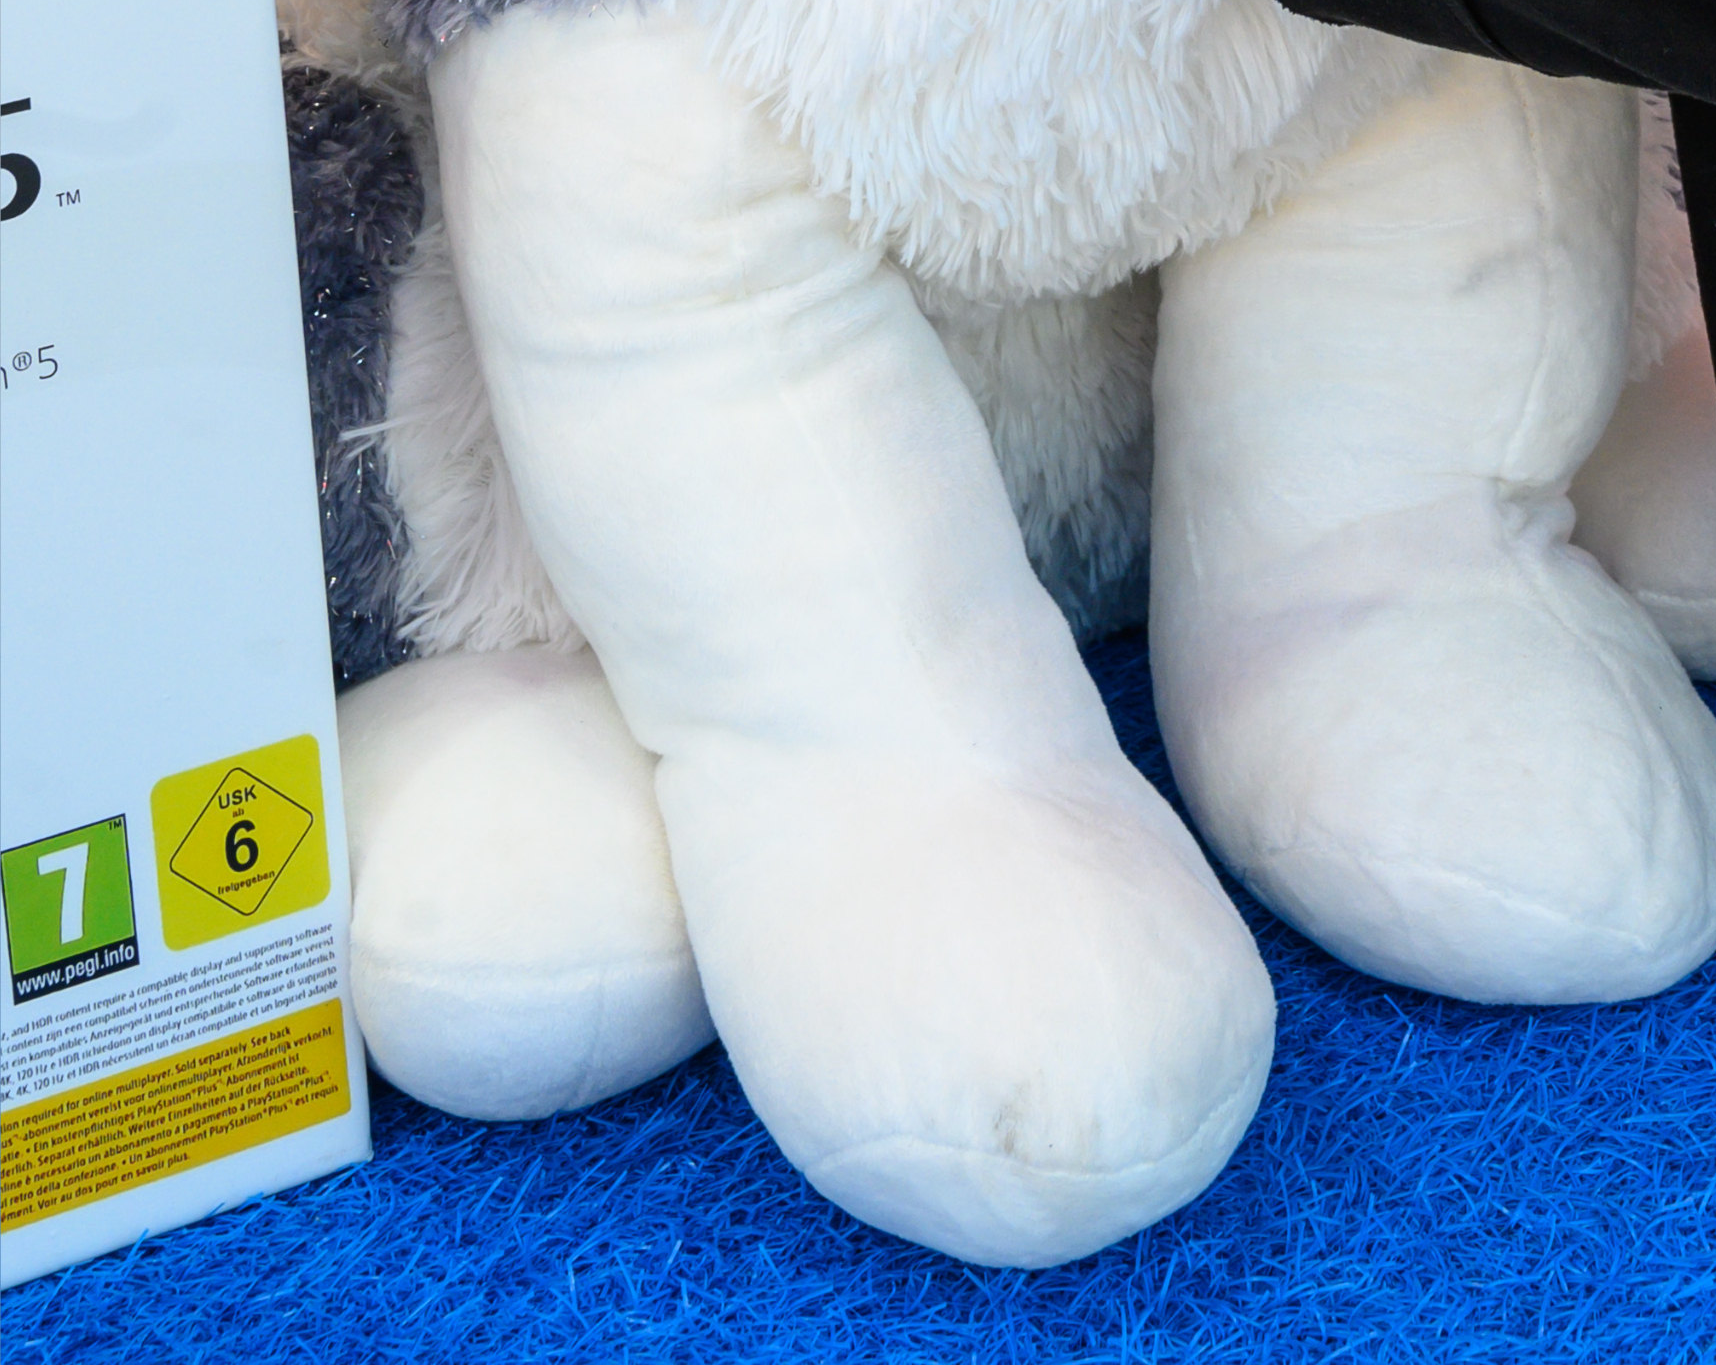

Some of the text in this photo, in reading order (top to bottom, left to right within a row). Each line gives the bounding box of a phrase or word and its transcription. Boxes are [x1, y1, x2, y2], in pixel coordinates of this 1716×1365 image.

[218, 784, 257, 810] USK
[232, 807, 245, 818] ab
[225, 819, 259, 873] 6
[37, 841, 90, 946] 7
[217, 870, 276, 896] freigegeben
[16, 942, 136, 996] www.pegi.info
